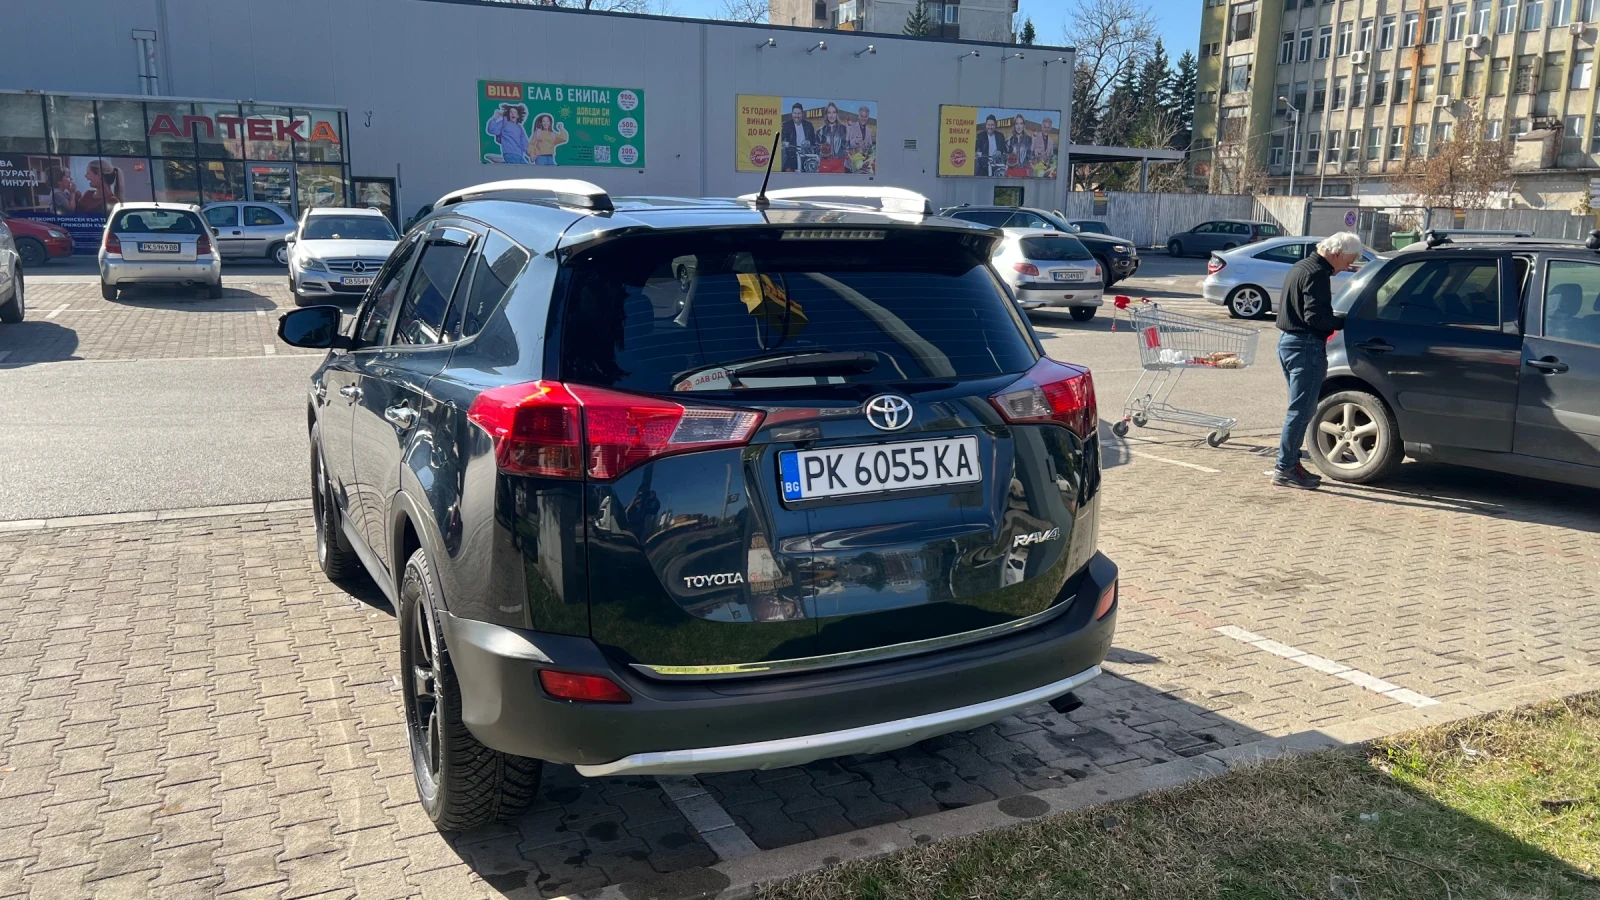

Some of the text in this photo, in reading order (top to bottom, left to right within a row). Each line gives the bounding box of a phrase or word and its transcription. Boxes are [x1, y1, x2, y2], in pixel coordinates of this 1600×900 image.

[488, 85, 520, 98] BILLA
[528, 86, 610, 103] ЕЛА В ЕКИПА!
[577, 107, 610, 117] ДОВЕДИ СИ
[751, 107, 778, 116] ГОДИНИ
[147, 114, 340, 143] АПТЕКА
[582, 117, 611, 126] ПРИЯТЕЛ!
[804, 444, 973, 491] PK 6055 KA
[785, 482, 799, 493] BG
[1013, 526, 1061, 548] RAV4
[684, 572, 744, 588] TOYOTA
